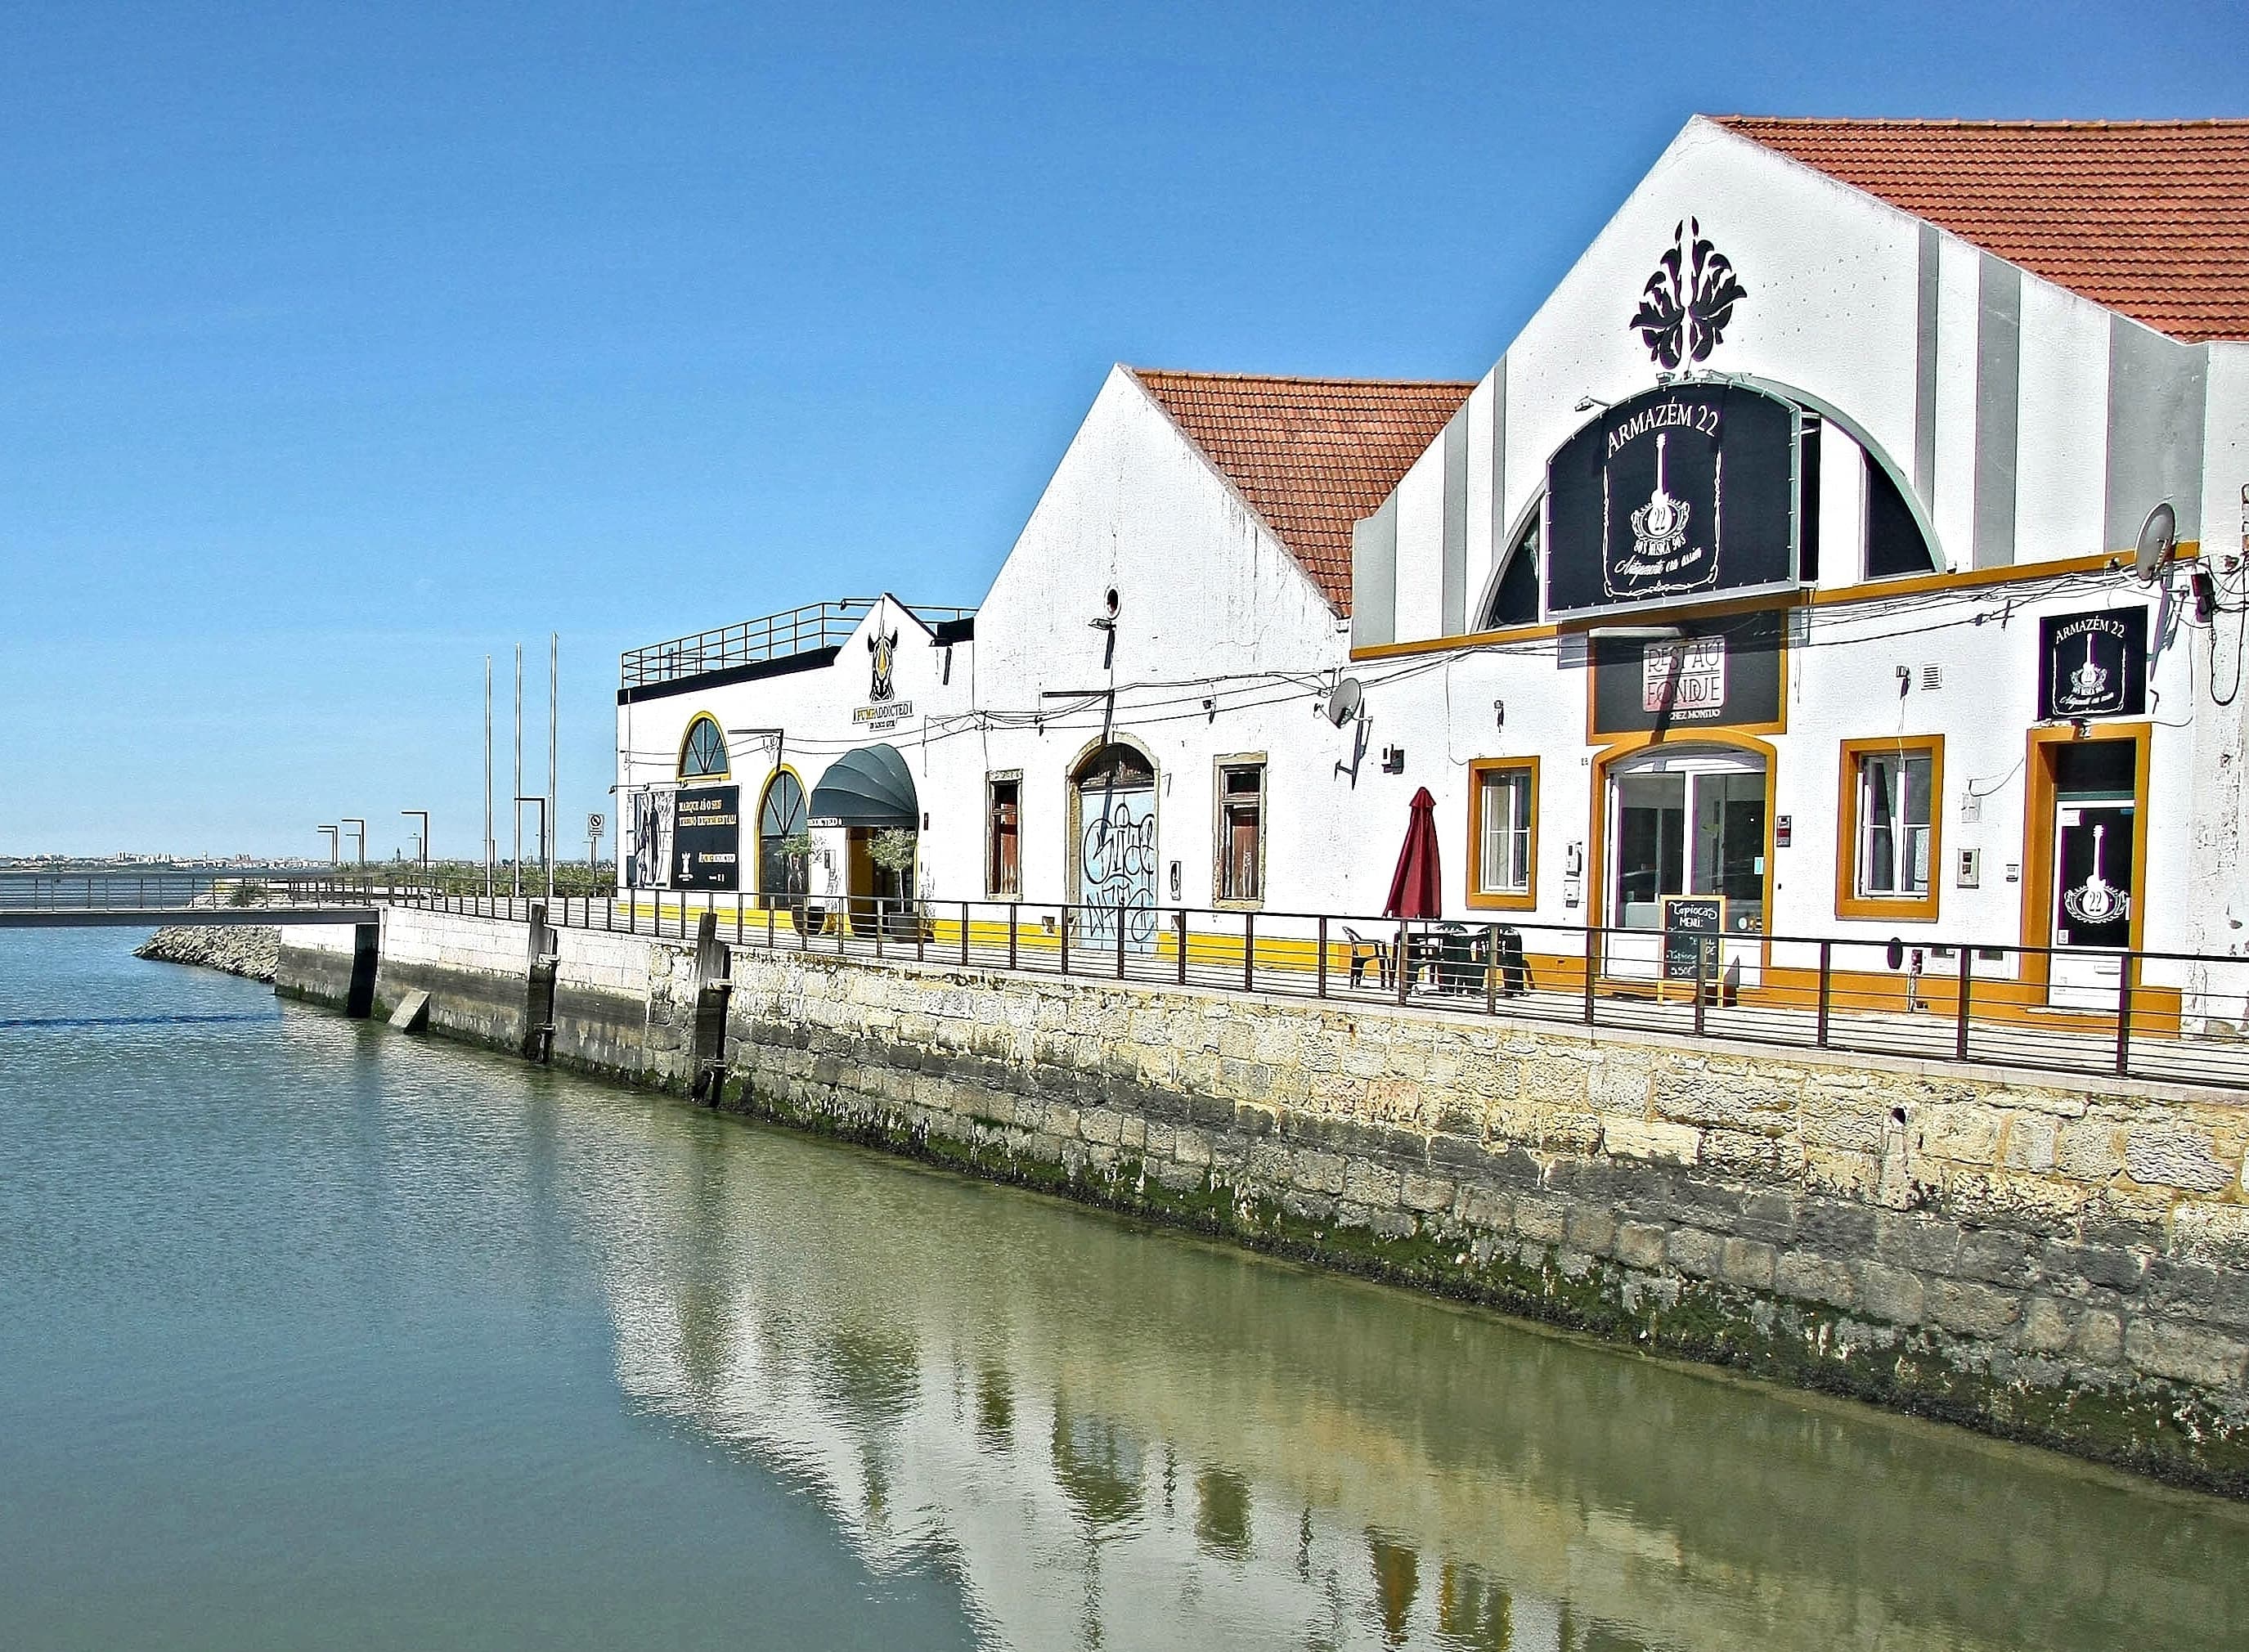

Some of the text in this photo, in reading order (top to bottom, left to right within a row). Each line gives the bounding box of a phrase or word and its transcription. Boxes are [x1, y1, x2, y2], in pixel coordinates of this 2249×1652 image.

[1606, 396, 1720, 460] ARMAZÉM 22
[1654, 506, 1666, 532] 22
[2055, 614, 2126, 644] ARMAZÉM 22
[1668, 901, 1718, 920] Tapiocas
[2089, 891, 2102, 913] 22
